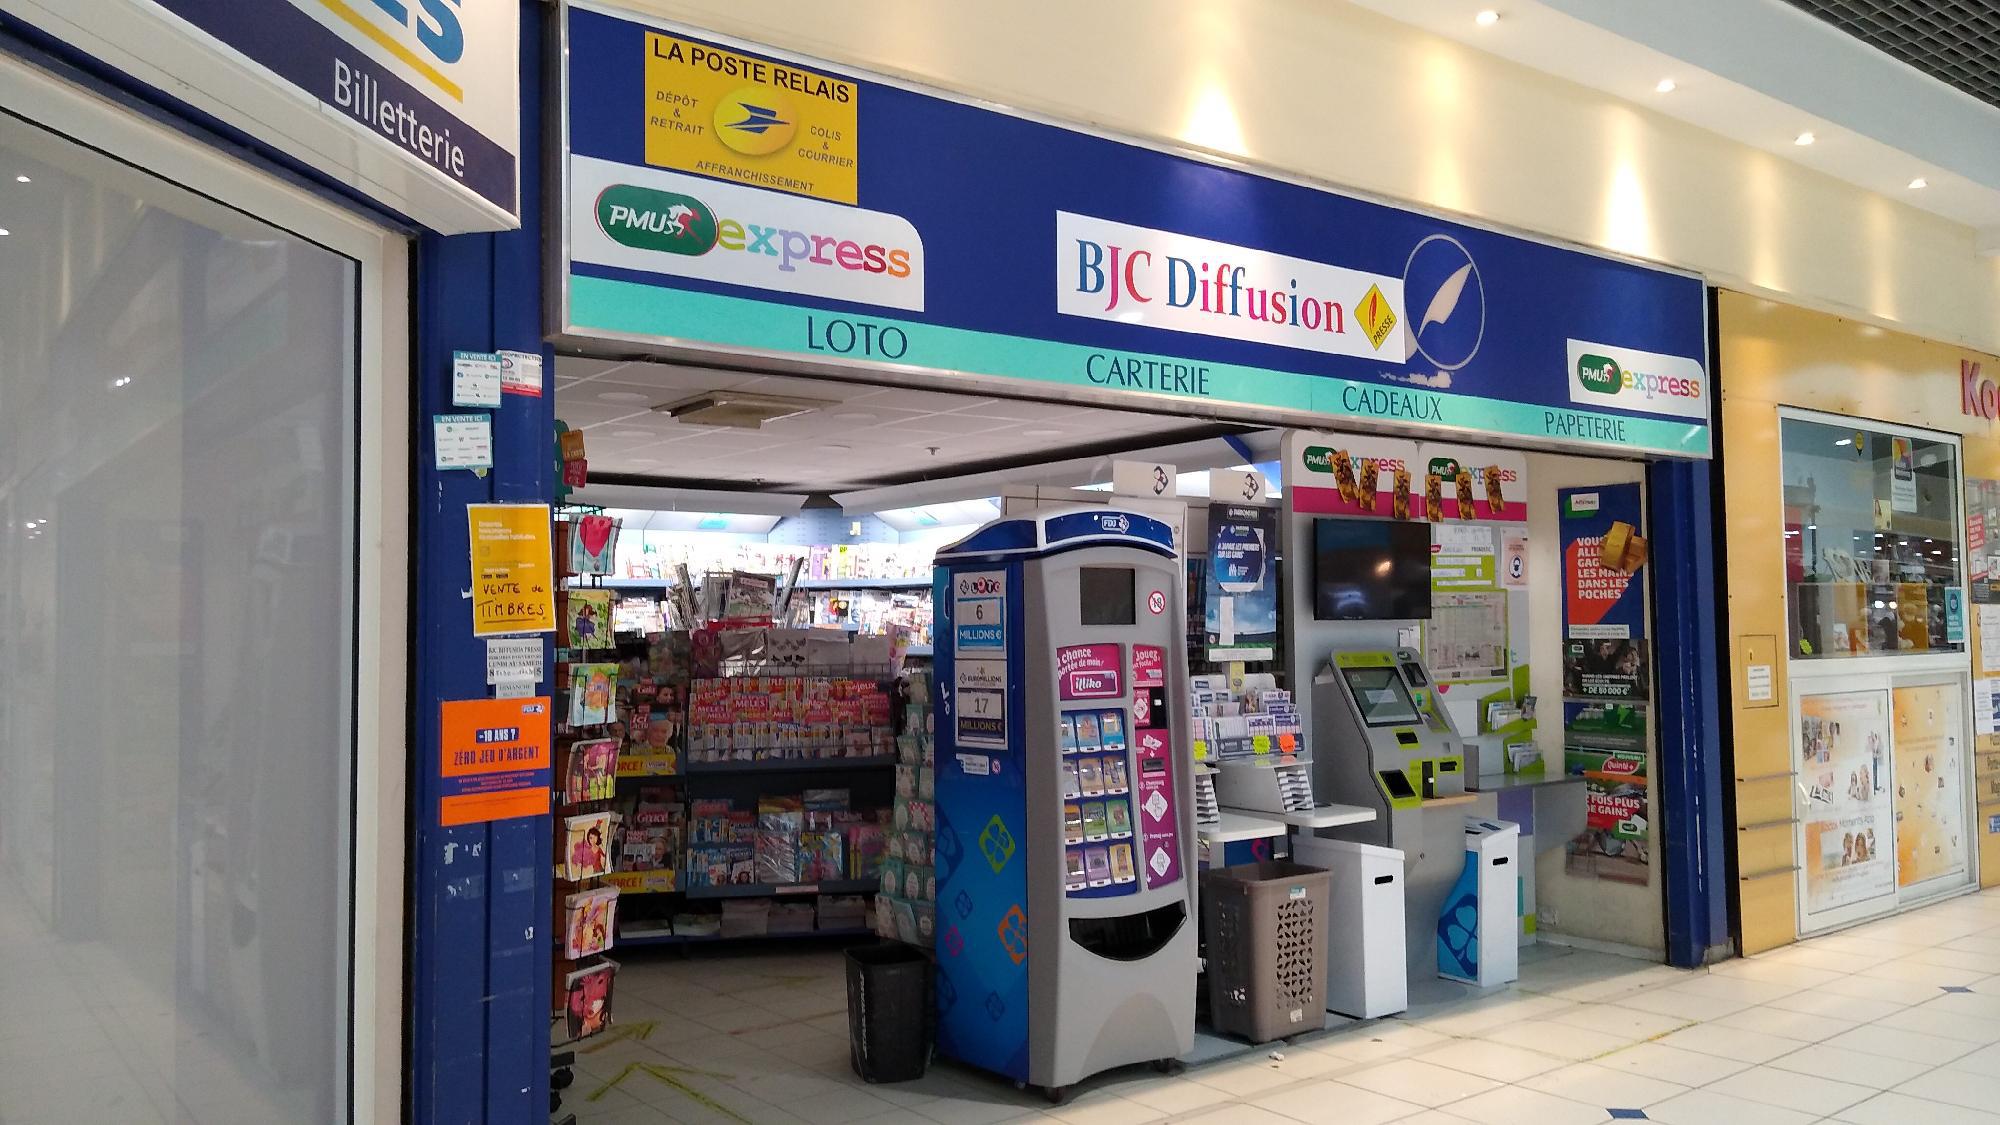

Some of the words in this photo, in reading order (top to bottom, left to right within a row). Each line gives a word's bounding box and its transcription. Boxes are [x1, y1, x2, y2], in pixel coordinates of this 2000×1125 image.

[653, 37, 685, 64] LA
[691, 46, 767, 85] POSTE
[773, 66, 850, 104] RELAIS
[656, 89, 699, 109] DÉPÔT
[334, 57, 465, 178] Billetterie
[673, 107, 681, 118] &
[650, 116, 704, 136] RETRAIT
[810, 125, 842, 142] COLIS
[822, 140, 830, 150] &
[798, 147, 854, 169] COURRIER
[695, 159, 815, 193] AFFRANCHISSEMENT
[609, 204, 669, 234] PMU
[717, 218, 912, 279] express
[1075, 237, 1153, 313] BJC
[1165, 255, 1346, 335] Diffusion
[807, 315, 909, 360] LOTO
[1373, 314, 1394, 346] PRESSE
[1086, 353, 1210, 397] CARTERIE
[1581, 366, 1606, 382] PMU
[1621, 366, 1701, 400] express
[1342, 385, 1443, 422] CADEAUX
[1544, 411, 1626, 443] PAPETERIE
[1306, 454, 1324, 466] PMU
[1431, 466, 1449, 477] PMU
[1103, 518, 1117, 529] FDJ
[1578, 568, 1597, 579] LES
[483, 582, 521, 595] VENTE
[531, 584, 544, 594] de
[1578, 578, 1608, 589] DANS
[1609, 578, 1629, 589] LES
[1578, 588, 1622, 600] POCHES
[476, 597, 546, 618] TIMBRES
[976, 604, 984, 621] 6
[959, 629, 995, 640] MILLIONS
[995, 630, 1003, 640] €
[1061, 648, 1092, 664] chance
[1079, 658, 1086, 667] de
[1075, 676, 1102, 691] illiko
[1588, 686, 1598, 695] DE
[974, 698, 989, 714] 17
[960, 720, 997, 732] MILLIONS
[494, 729, 508, 742] ANS
[454, 749, 476, 766] ZÉRO
[479, 749, 495, 764] JEU
[498, 745, 540, 762] D'ARGENT
[1591, 796, 1614, 807] FOIS
[1614, 797, 1640, 809] PLUS
[1598, 806, 1629, 818] GAINS
